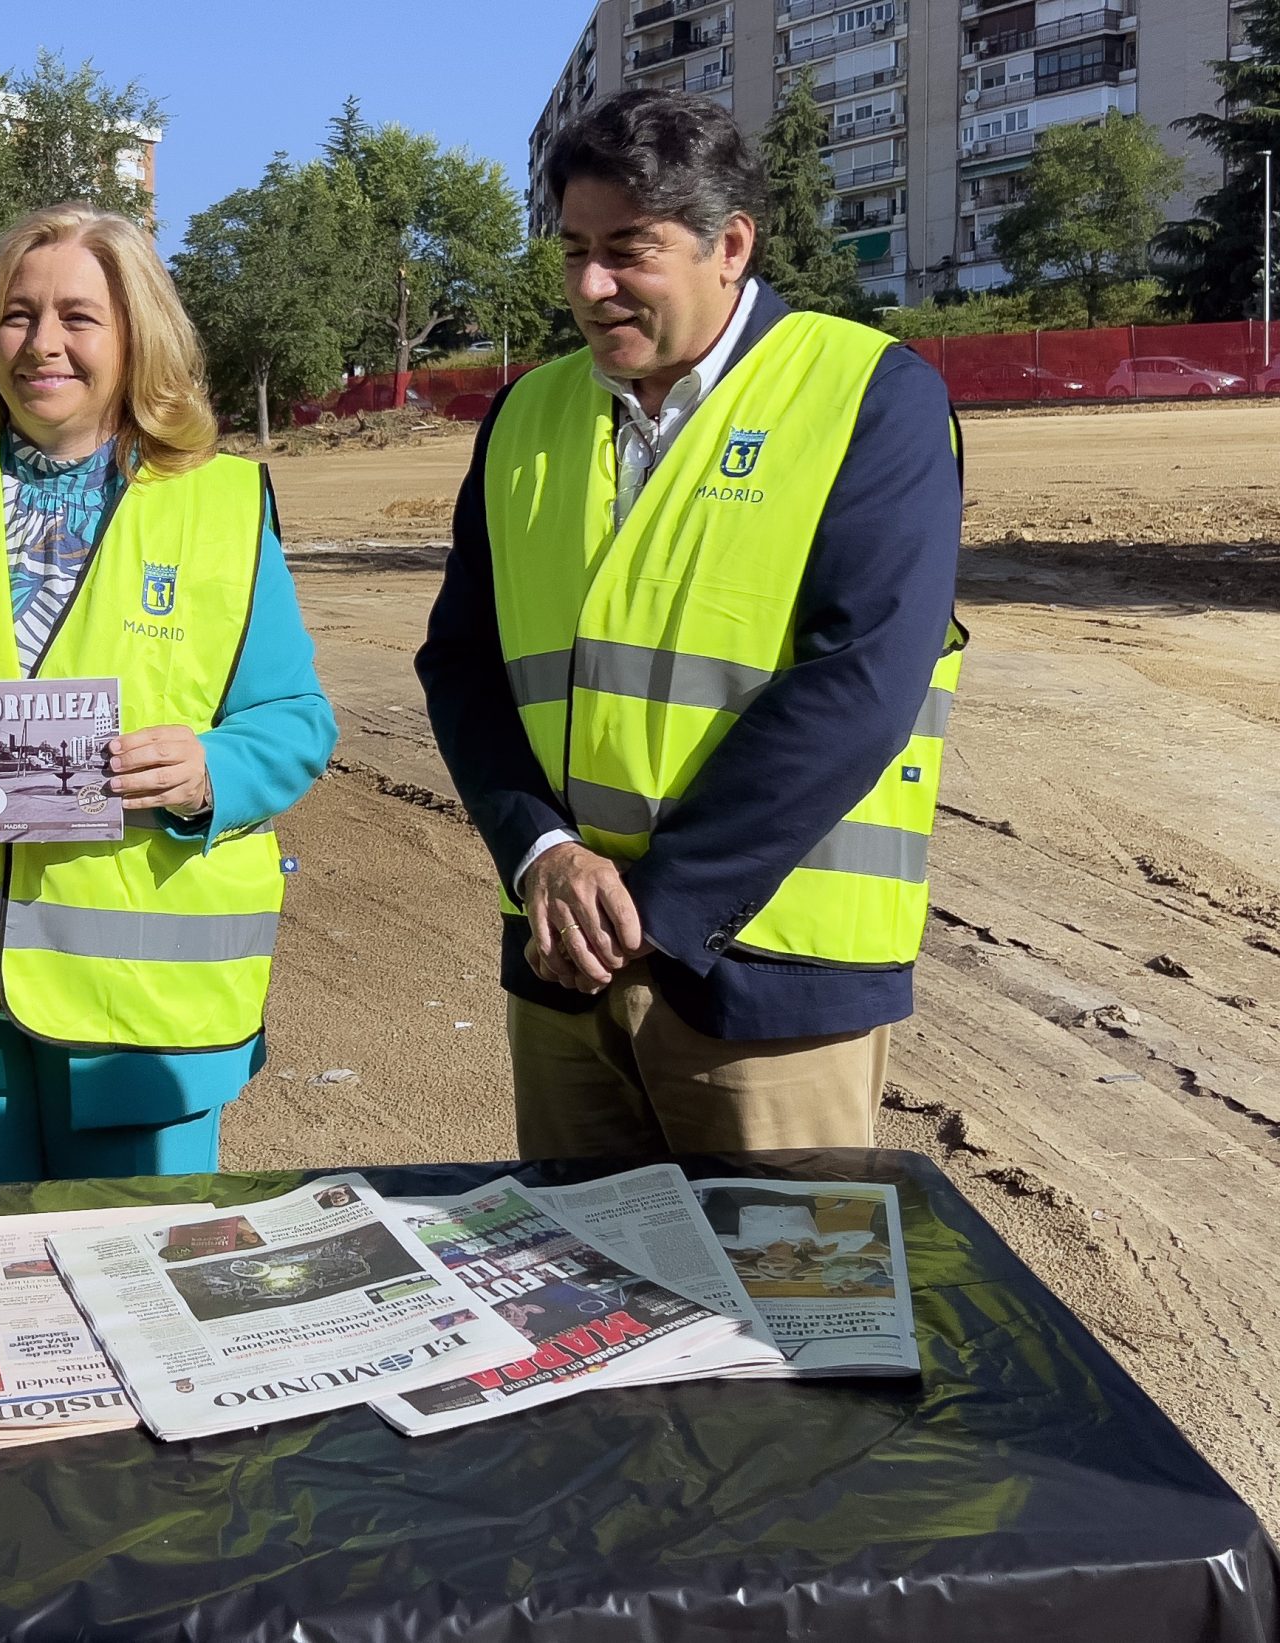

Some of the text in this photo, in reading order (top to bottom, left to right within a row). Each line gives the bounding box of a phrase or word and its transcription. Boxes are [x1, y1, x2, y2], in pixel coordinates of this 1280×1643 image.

[694, 485, 764, 502] MADRID
[123, 619, 184, 642] MADRID
[643, 1199, 684, 1212] Sánchez
[532, 1255, 586, 1280] EL
[438, 1296, 455, 1305] El
[409, 1301, 437, 1314] jefe
[312, 1309, 375, 1329] secretos
[372, 1315, 388, 1325] la
[389, 1309, 407, 1320] de
[803, 1311, 895, 1321] respaldar
[646, 1310, 713, 1339] Exhibición
[823, 1319, 875, 1328] sobre
[17, 1331, 68, 1341] Sabadell
[232, 1326, 300, 1344] Sánchez
[293, 1320, 370, 1341] Audiencia
[772, 1329, 815, 1337] abre
[819, 1327, 856, 1335] PNV
[9, 1336, 80, 1348] BBVA sobre
[222, 1338, 292, 1357] Nacional
[628, 1335, 646, 1347] de
[466, 1310, 651, 1390] MARCA
[583, 1343, 628, 1364] España
[213, 1332, 471, 1407] EL MUNDO
[554, 1367, 565, 1377] el
[566, 1360, 584, 1371] en
[17, 1376, 93, 1390] Sabadell
[504, 1372, 551, 1392] estreno
